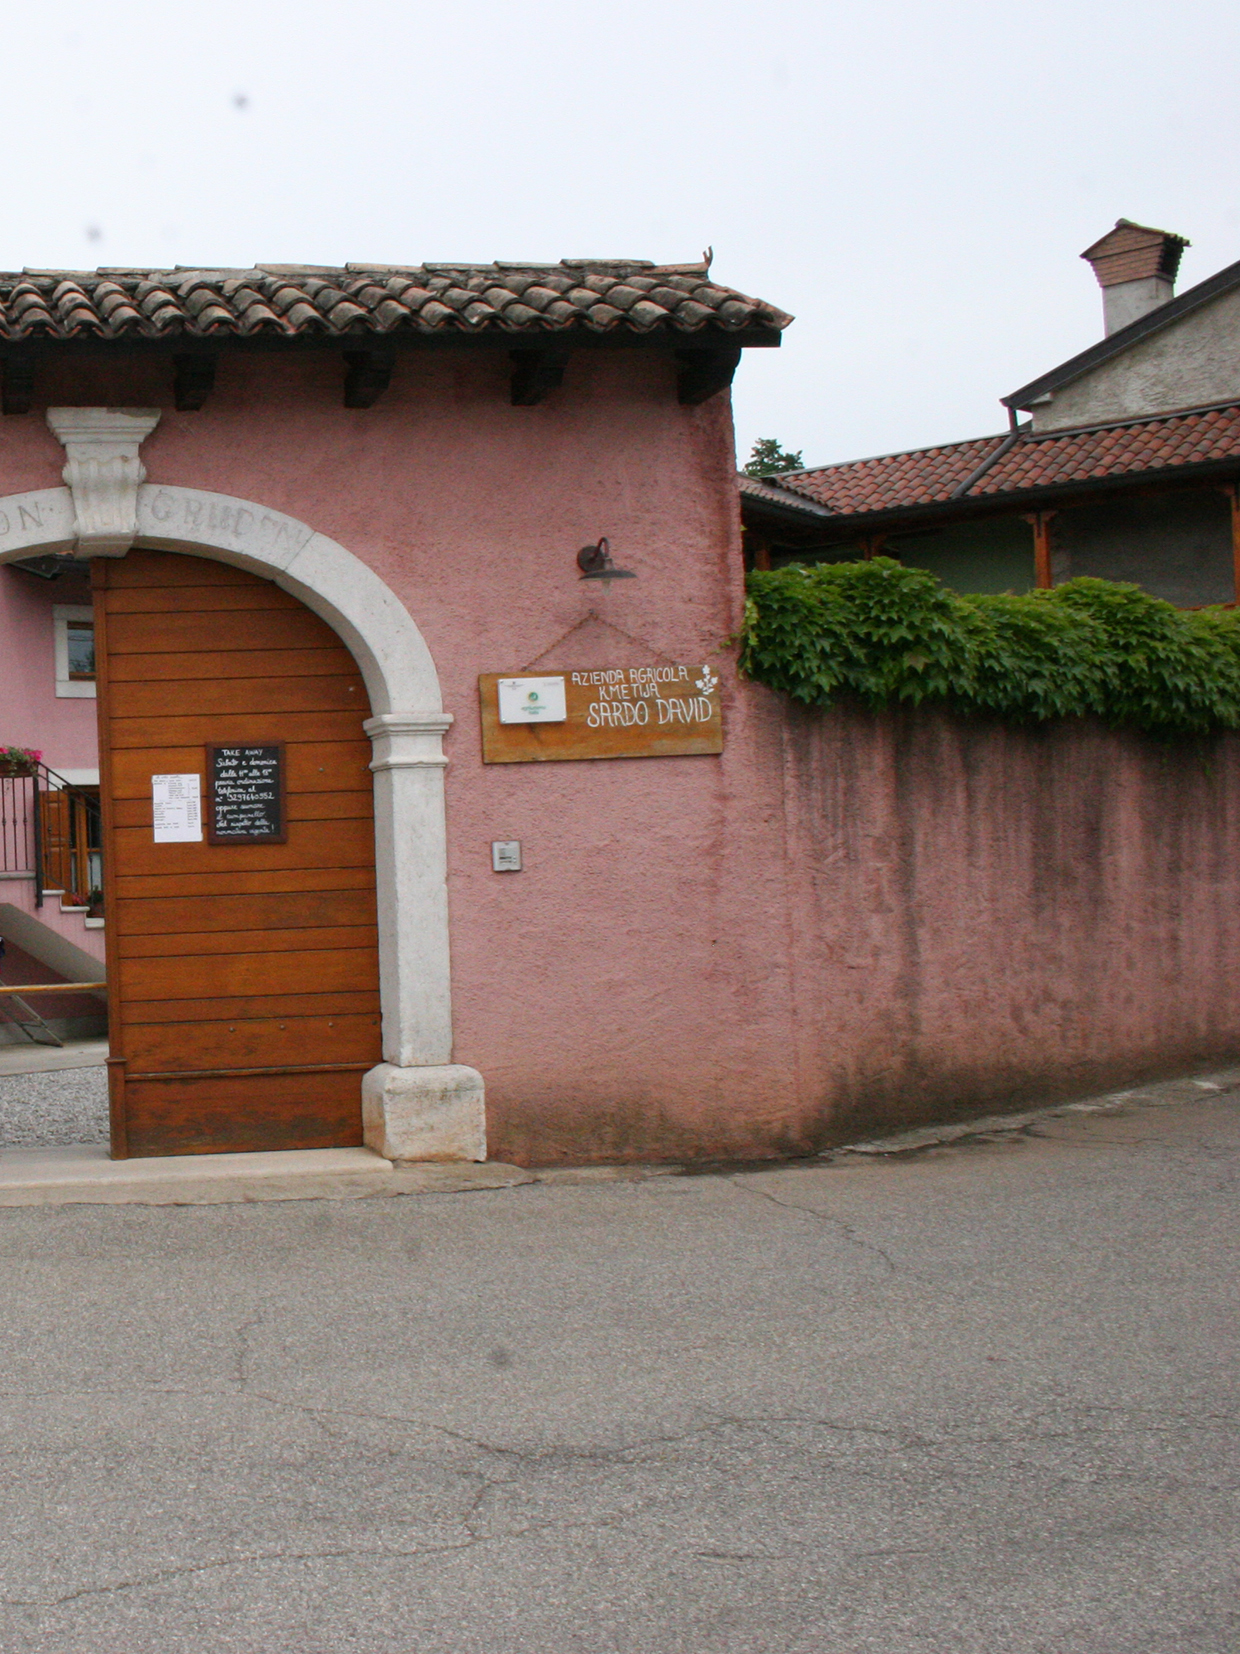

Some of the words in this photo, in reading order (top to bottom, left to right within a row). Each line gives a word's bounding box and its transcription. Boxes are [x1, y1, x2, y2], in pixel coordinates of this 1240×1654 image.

[571, 669, 624, 686] AZIENDA
[629, 666, 689, 683] AGRICOLA
[598, 683, 660, 701] KMETIJA
[586, 701, 649, 728] SARDO
[656, 697, 712, 724] DAVID
[221, 749, 241, 757] TAKE
